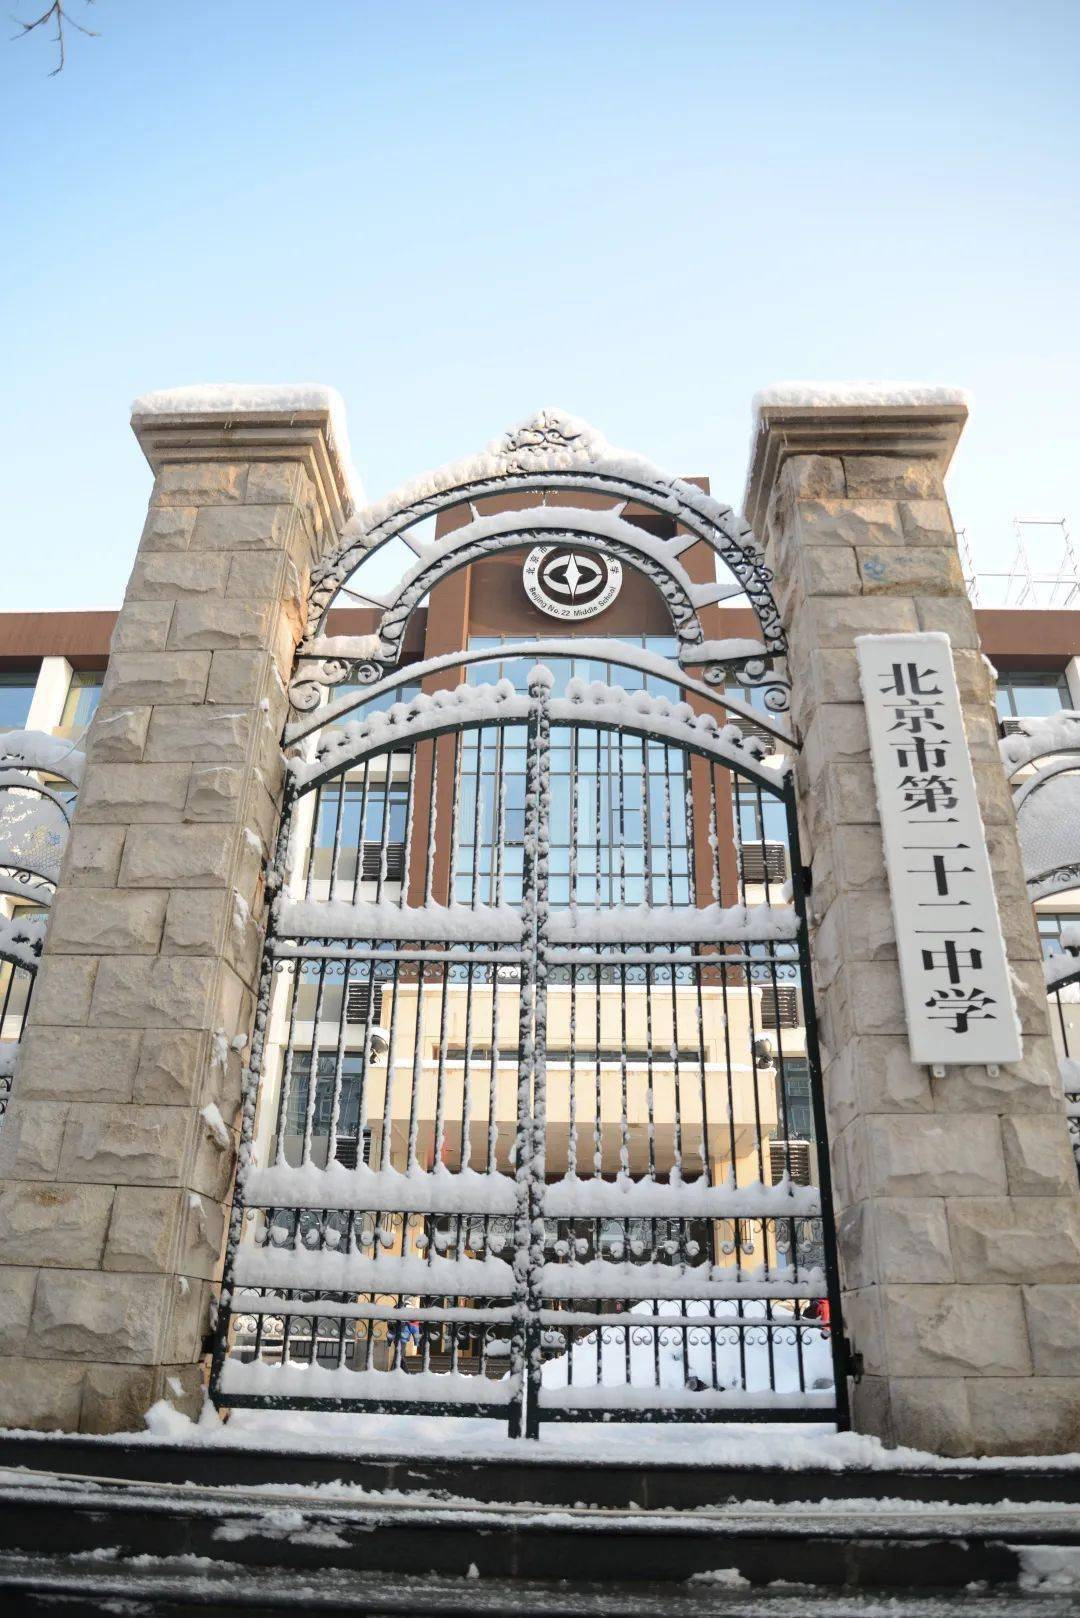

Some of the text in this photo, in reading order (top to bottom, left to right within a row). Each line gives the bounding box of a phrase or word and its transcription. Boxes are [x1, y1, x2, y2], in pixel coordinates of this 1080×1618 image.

[529, 587, 548, 608] Beijing
[573, 606, 598, 617] Middle
[598, 586, 616, 607] School
[877, 662, 998, 1034] 北京市第二十二中学
